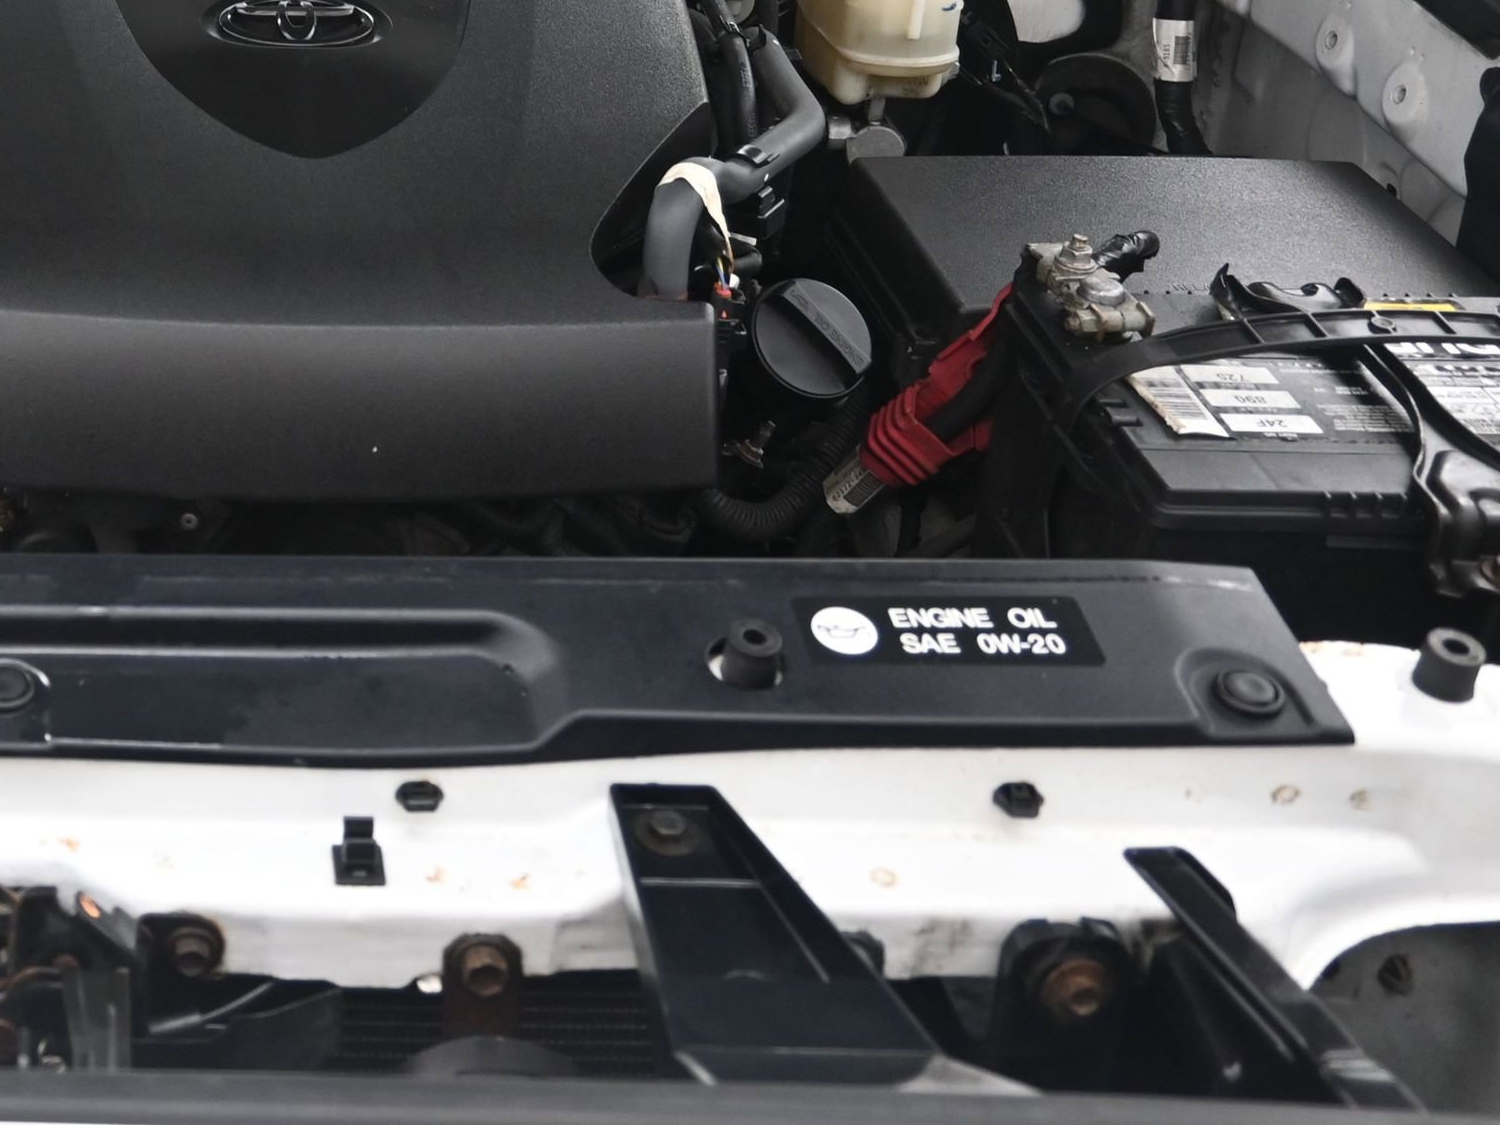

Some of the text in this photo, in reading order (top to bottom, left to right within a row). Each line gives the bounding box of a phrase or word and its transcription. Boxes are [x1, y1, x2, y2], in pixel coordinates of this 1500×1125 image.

[1216, 373, 1244, 382] 725
[1257, 418, 1288, 428] 24F
[887, 607, 1058, 629] ENGINE OIL
[900, 633, 1067, 655] SAE 0W-20
